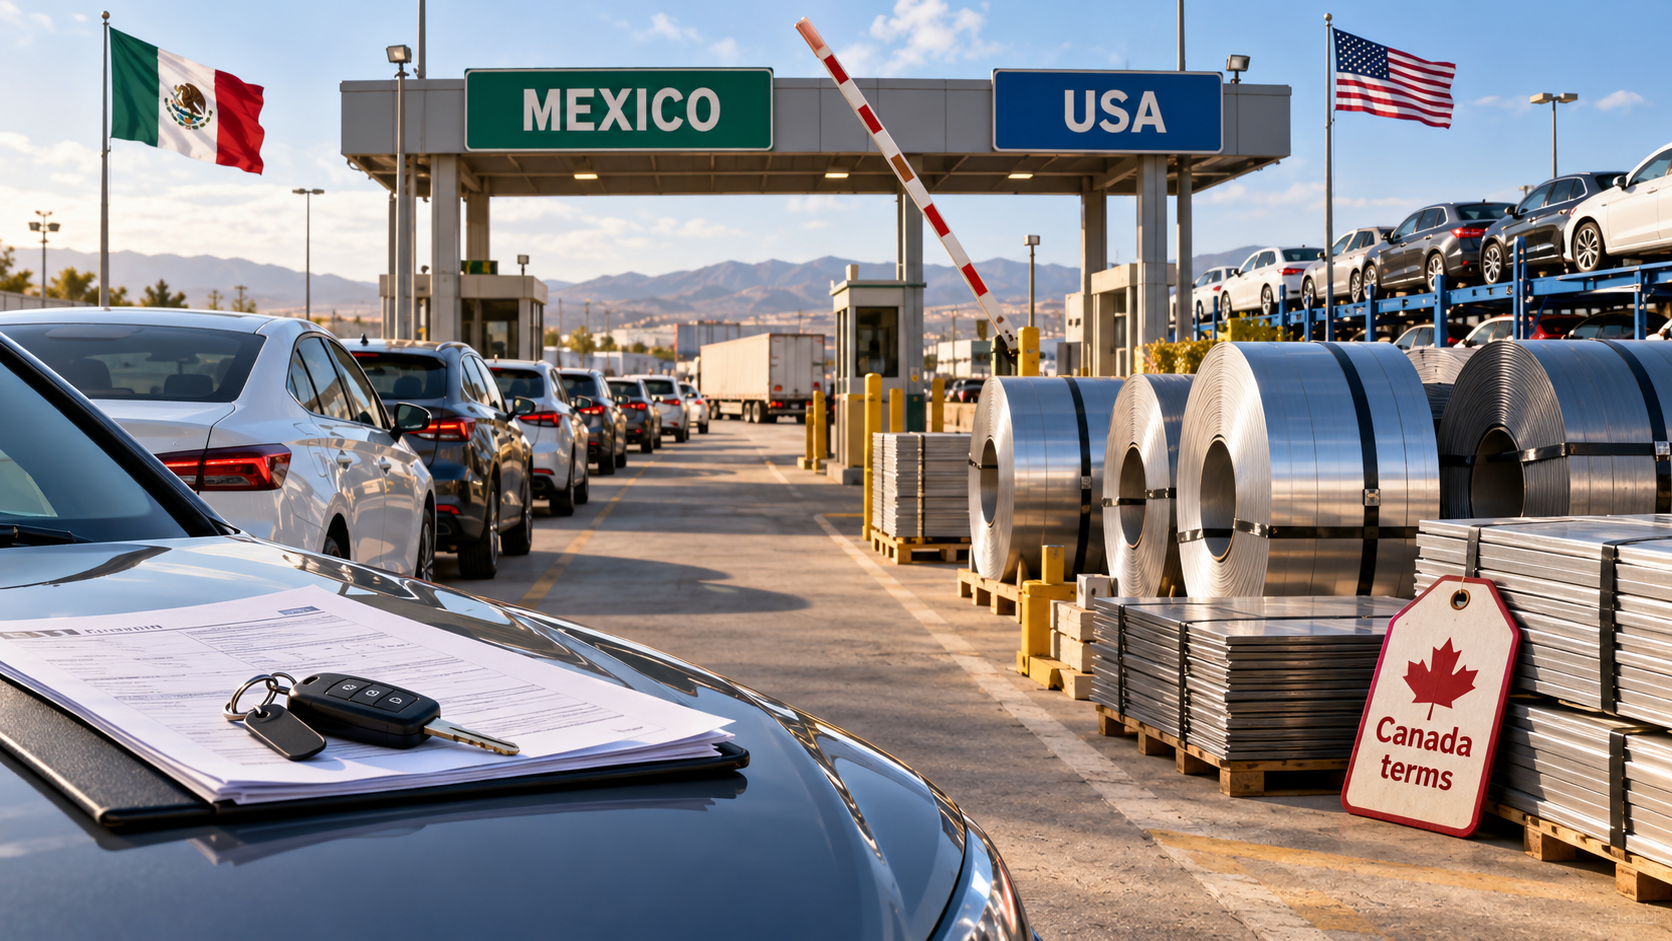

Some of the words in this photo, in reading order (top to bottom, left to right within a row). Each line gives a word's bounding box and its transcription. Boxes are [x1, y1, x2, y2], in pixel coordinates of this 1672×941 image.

[523, 88, 721, 132] MEXICO
[1064, 90, 1167, 134] USA
[1376, 716, 1473, 758] Canada
[1380, 754, 1454, 791] terms
